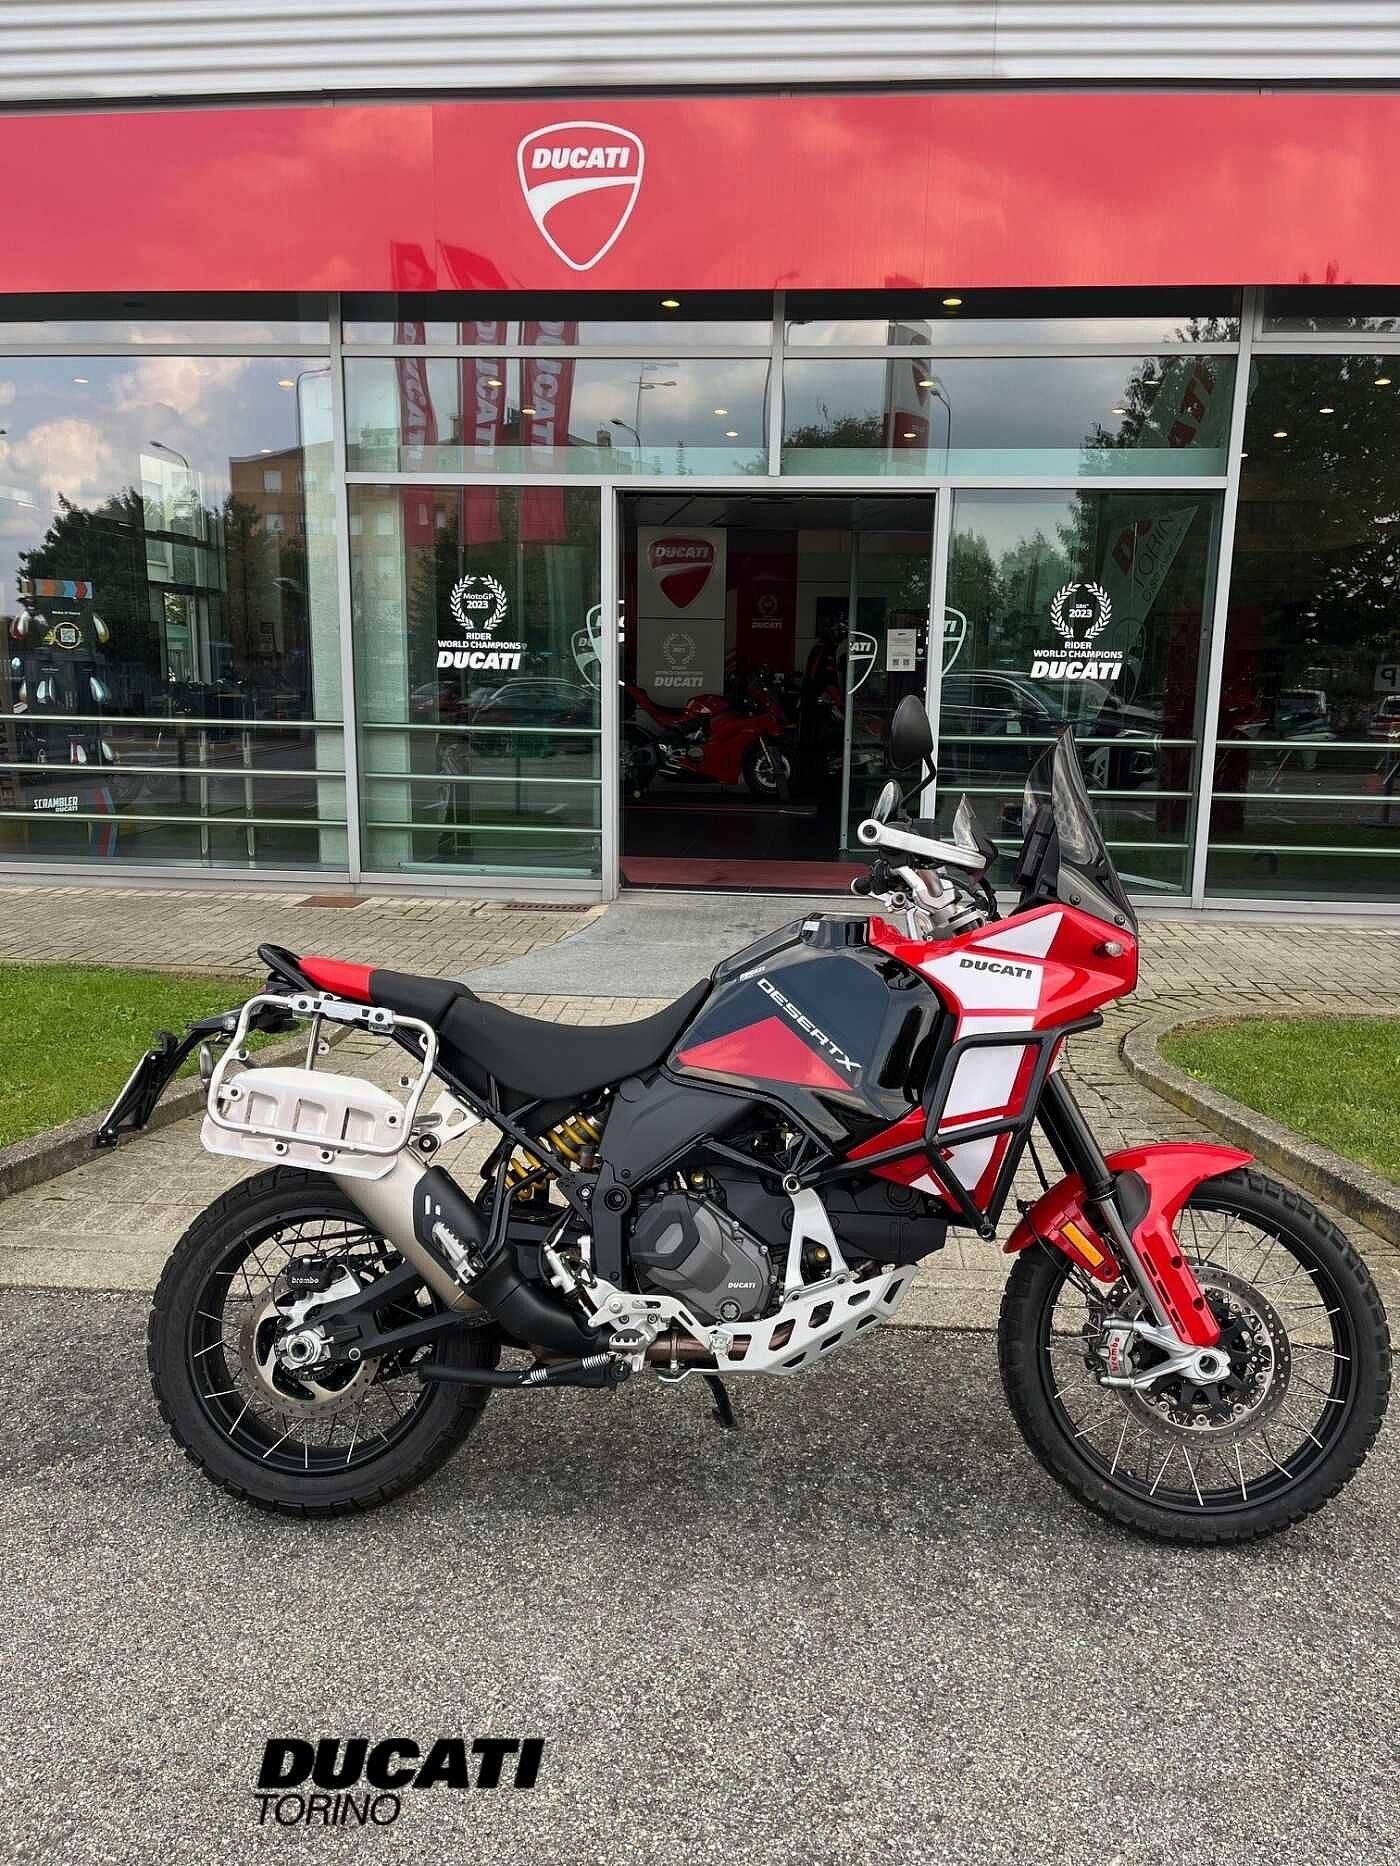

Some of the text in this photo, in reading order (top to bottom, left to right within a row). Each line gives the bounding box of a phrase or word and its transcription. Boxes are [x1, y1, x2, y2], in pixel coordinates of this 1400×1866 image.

[531, 147, 630, 169] DUCATI
[655, 546, 709, 559] DUCATI
[466, 601, 489, 609] 2023
[1068, 609, 1093, 618] 2023
[466, 632, 492, 640] RIDER
[437, 640, 521, 650] WORLD CHAMPIONS
[1064, 642, 1092, 650] RIDER
[1033, 649, 1123, 659] WORLD CHAMPIONS
[436, 651, 521, 670] DUCATI
[1030, 660, 1123, 680] DUCATI
[654, 677, 704, 688] DUCATI
[33, 796, 79, 810] SCRAMBLER
[959, 958, 1033, 979] DUCATI
[757, 977, 863, 1072] DESERTX
[291, 1276, 319, 1284] brembo
[1111, 1337, 1120, 1372] brembo
